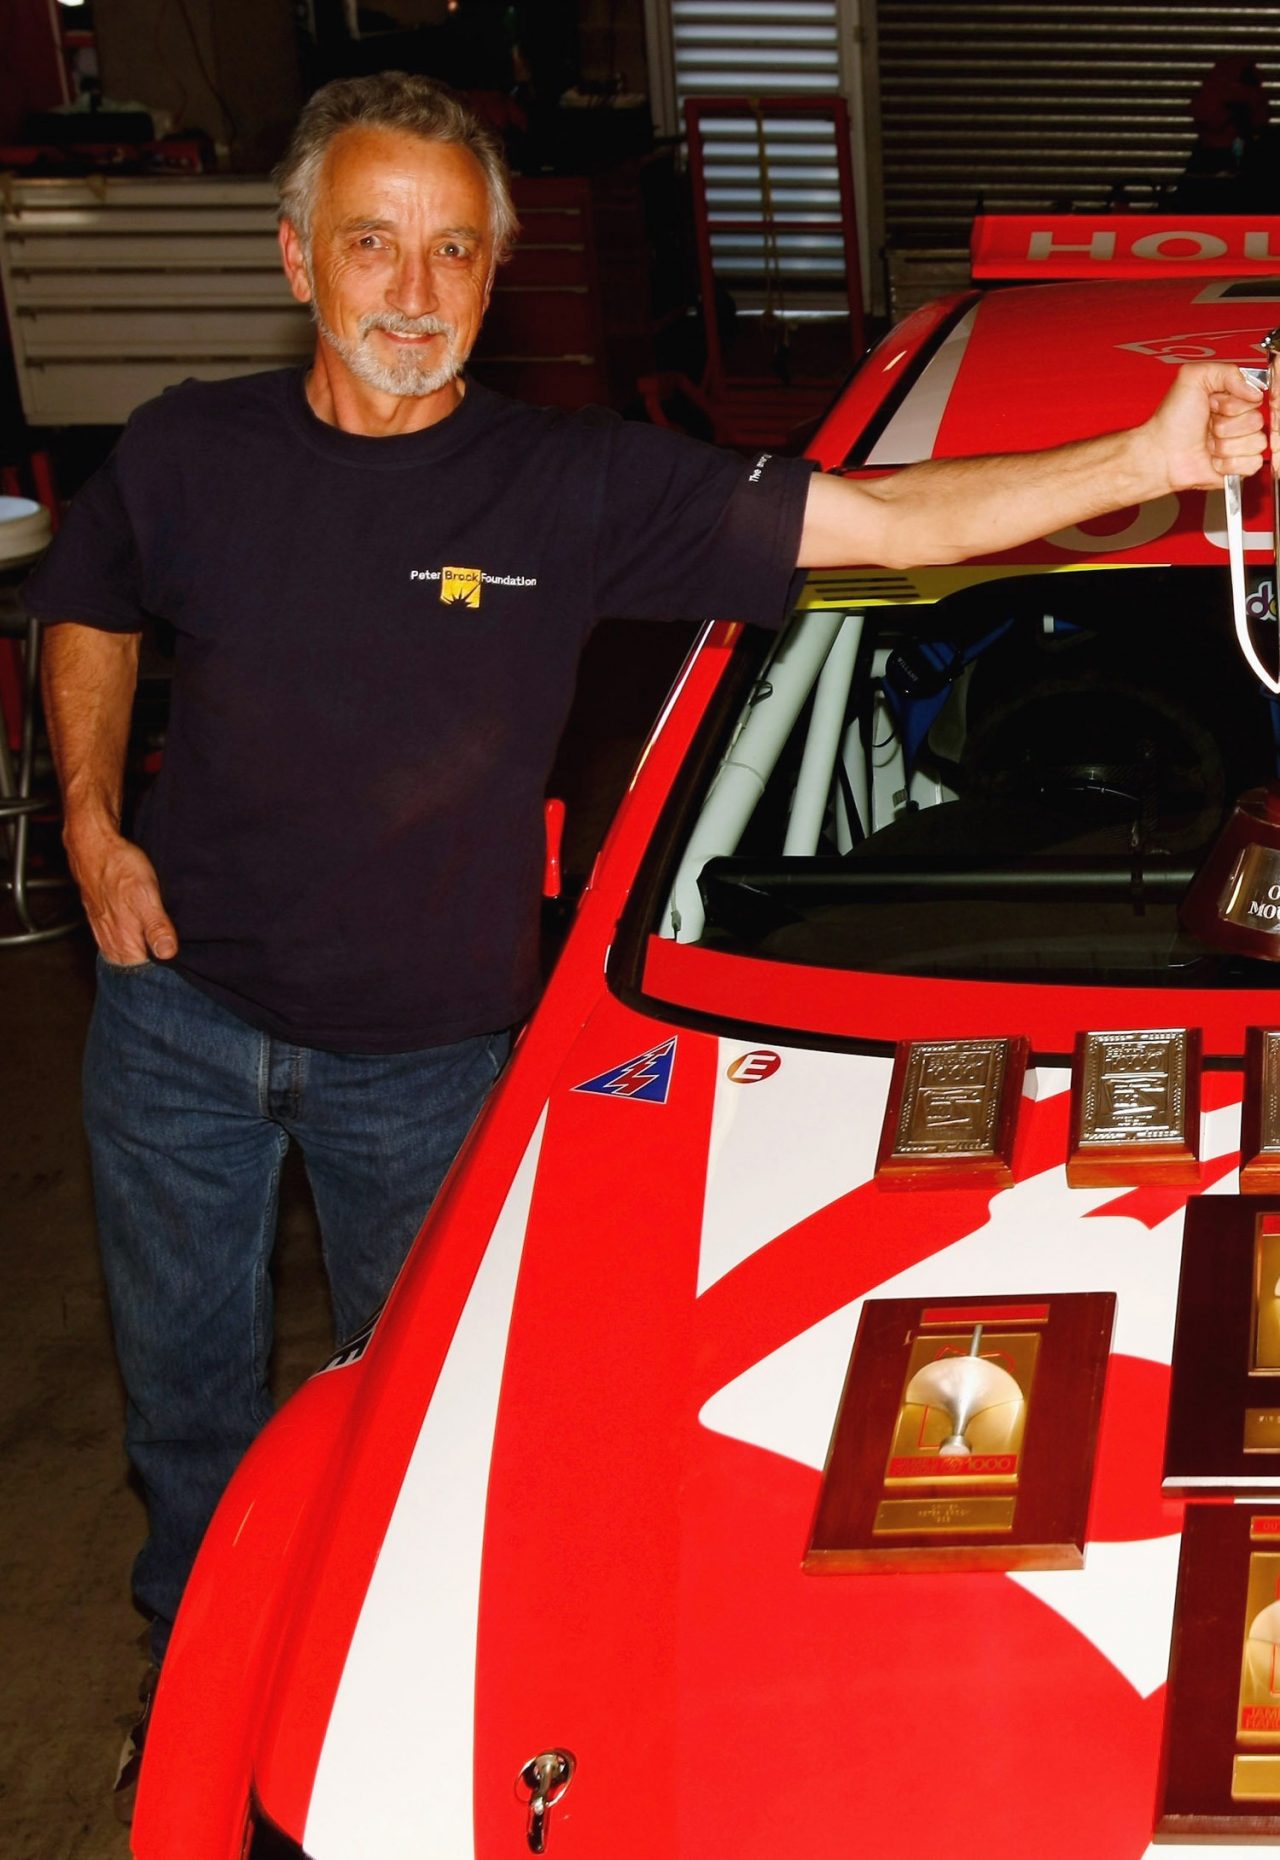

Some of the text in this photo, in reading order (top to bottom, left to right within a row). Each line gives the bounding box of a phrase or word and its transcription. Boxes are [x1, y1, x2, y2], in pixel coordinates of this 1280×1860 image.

[410, 570, 537, 587] Peter Brock Foundation
